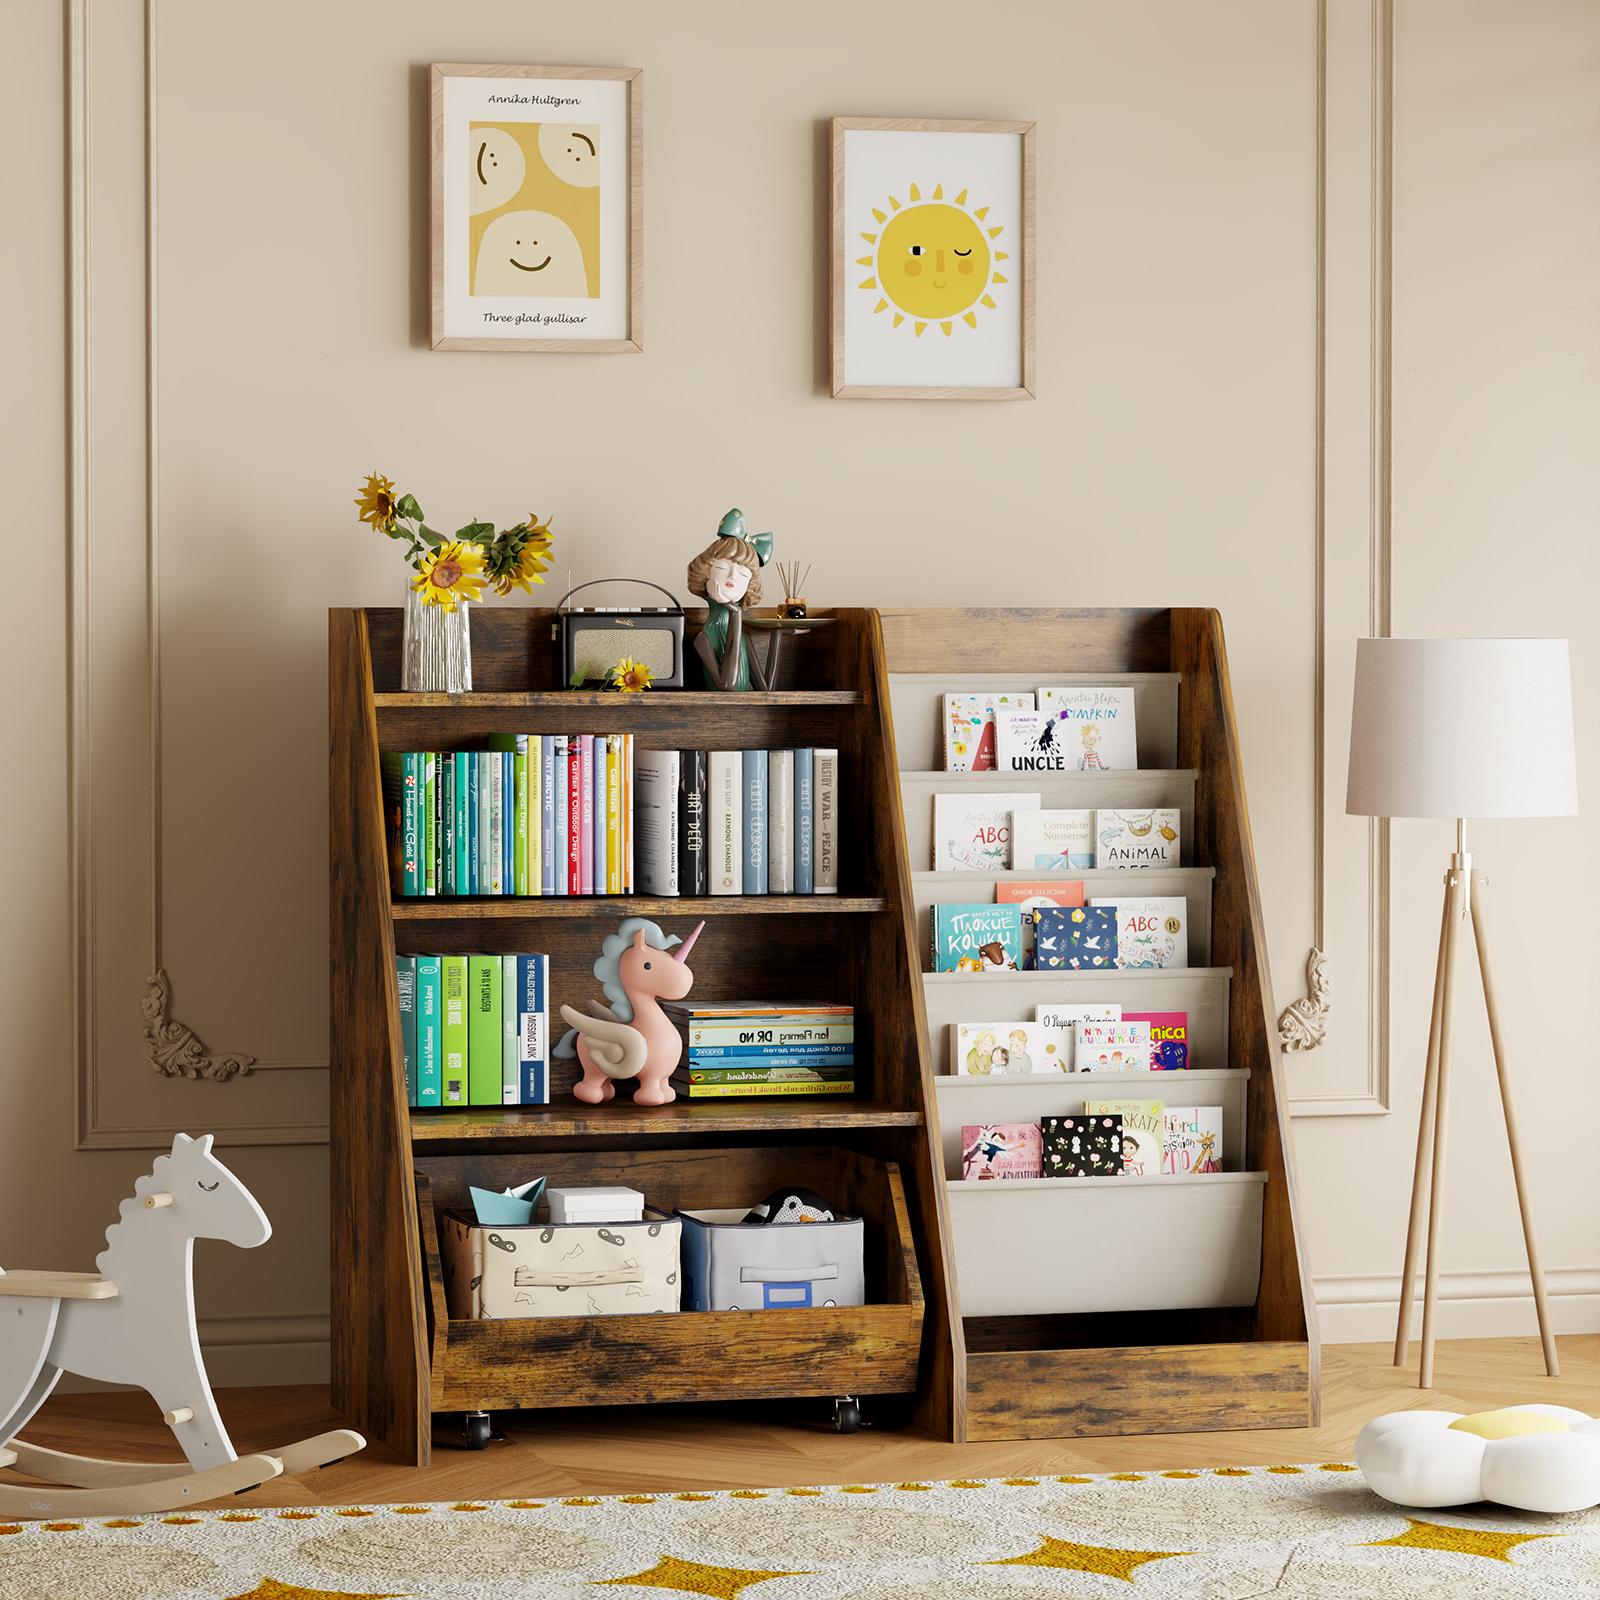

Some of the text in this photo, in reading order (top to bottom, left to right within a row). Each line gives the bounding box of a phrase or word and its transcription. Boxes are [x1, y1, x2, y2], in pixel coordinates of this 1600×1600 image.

[488, 94, 581, 108] Annika Hultgren
[483, 313, 587, 326] Three glad gullisar
[1012, 756, 1065, 770] UNCLE
[687, 792, 701, 851] ART DECO
[821, 758, 832, 872] TOLSTOY WAR PEACE
[1043, 820, 1088, 831] Complete
[972, 827, 1009, 844] ABC
[1043, 832, 1088, 841] Nonsense
[571, 836, 579, 862] Design
[1125, 916, 1158, 933] ABC
[527, 960, 535, 970] THE
[527, 971, 535, 988] PALEO
[527, 988, 535, 1012] DIETER'S
[527, 1015, 536, 1042] MISSING
[1052, 1015, 1082, 1030] Peque
[1151, 1026, 1185, 1041] nica
[527, 1044, 536, 1058] LINK
[1124, 1112, 1160, 1133] SKATT
[1164, 1109, 1199, 1133] tford
